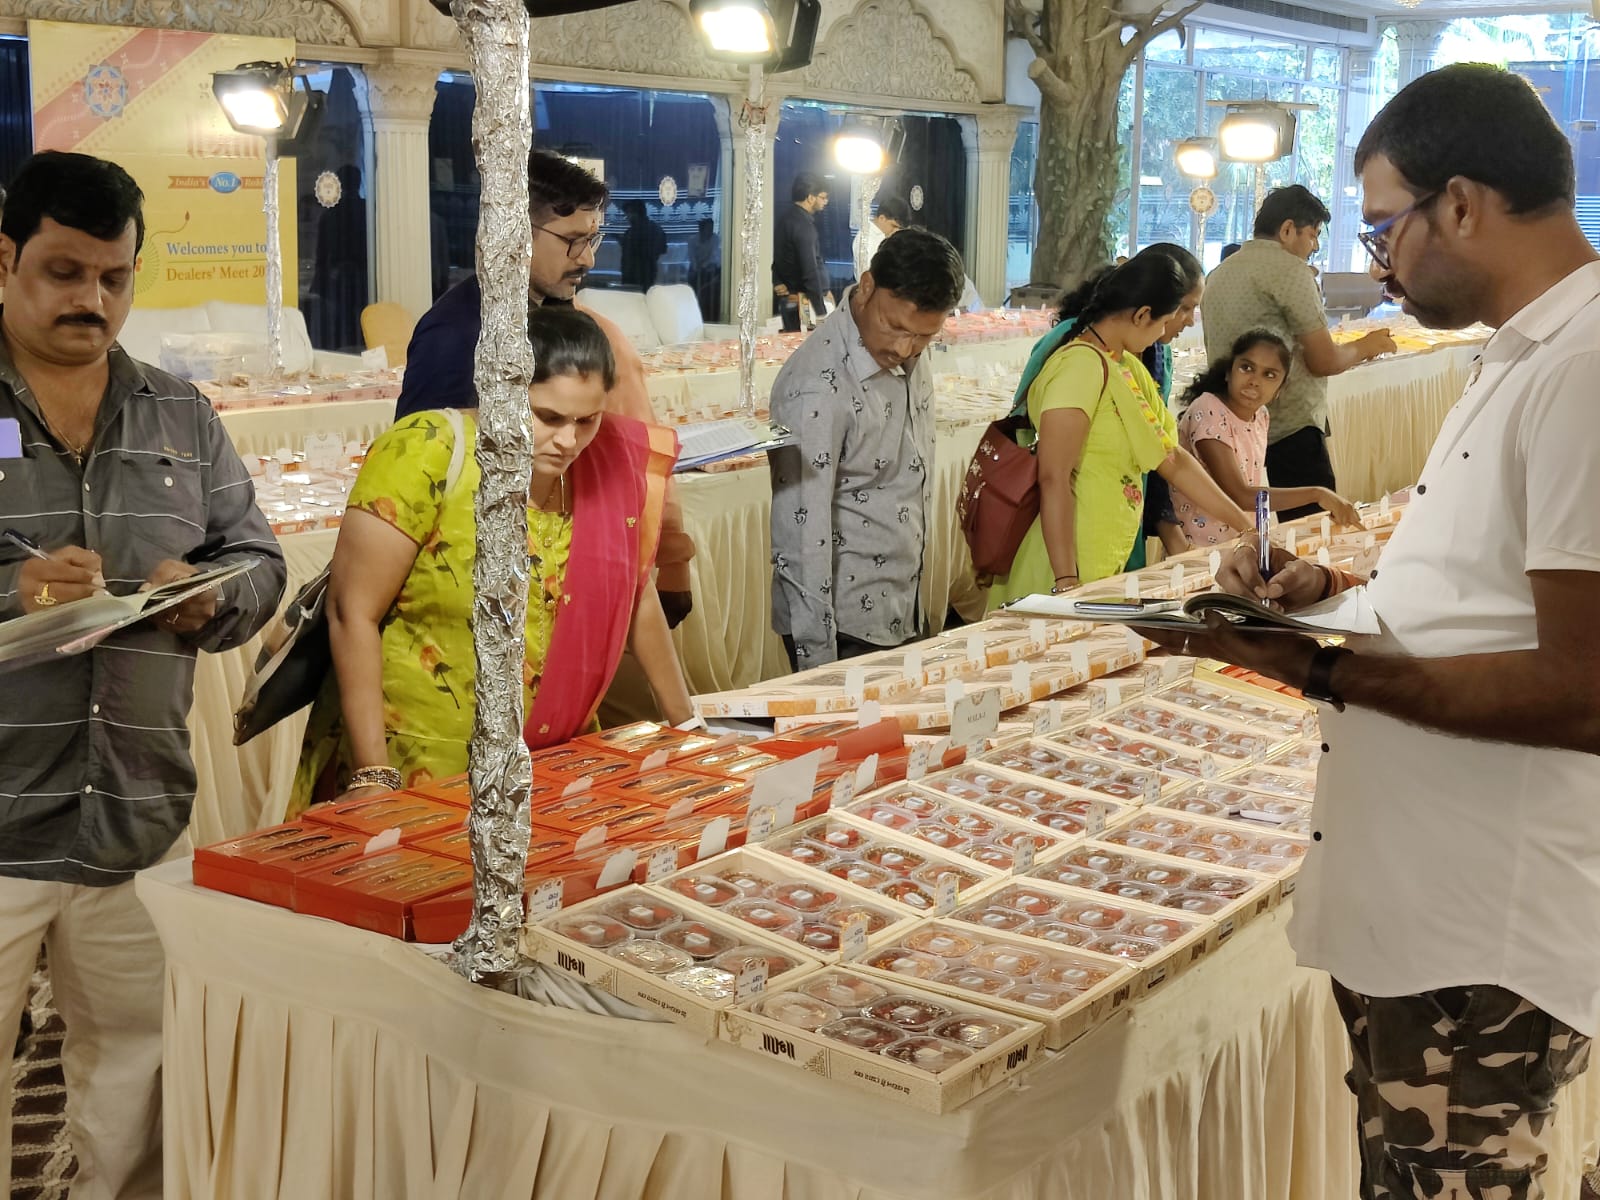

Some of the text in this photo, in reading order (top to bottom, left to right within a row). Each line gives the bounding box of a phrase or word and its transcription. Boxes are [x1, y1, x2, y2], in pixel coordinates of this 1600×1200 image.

[167, 241, 267, 258] Welcomes you to
[167, 265, 266, 281] Dealers' Meet 20
